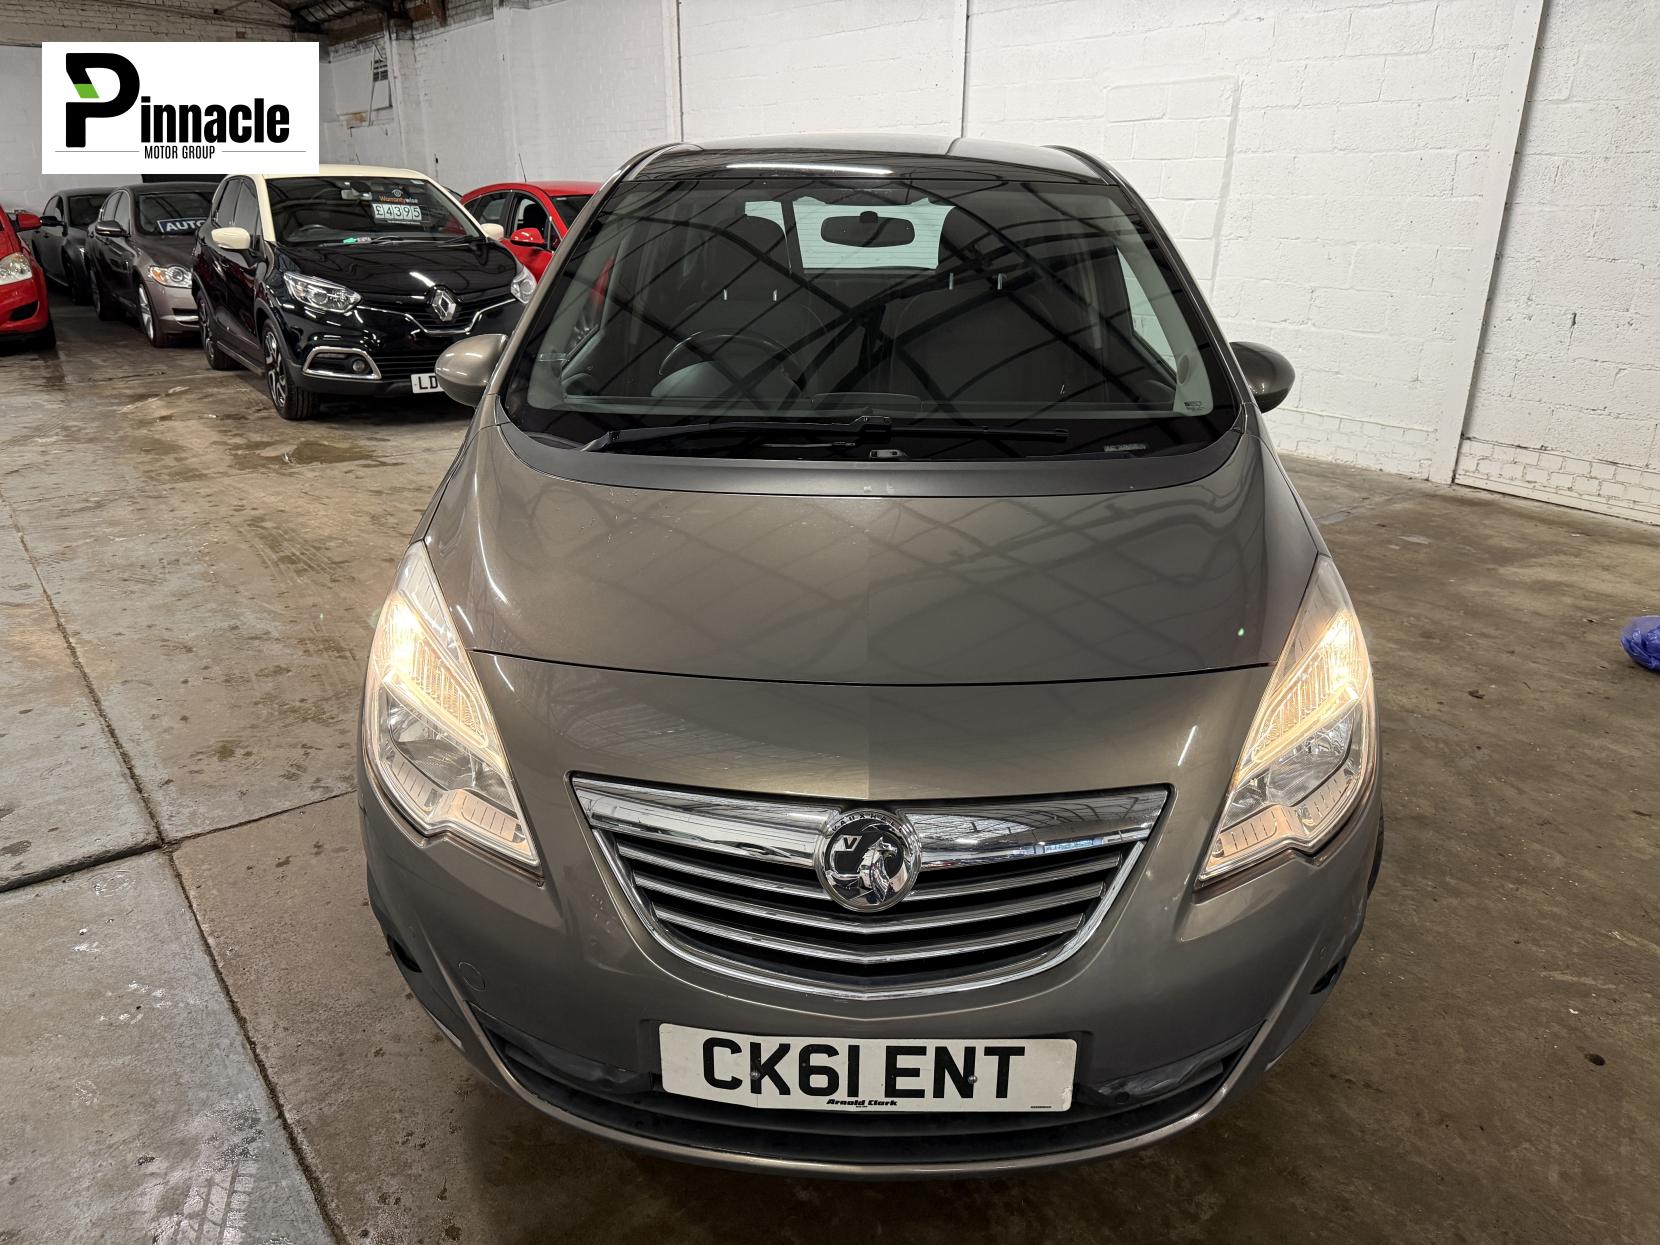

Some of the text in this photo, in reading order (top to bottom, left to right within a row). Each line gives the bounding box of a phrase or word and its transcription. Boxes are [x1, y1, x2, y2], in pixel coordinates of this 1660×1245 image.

[376, 206, 421, 218] £4395
[703, 1037, 1026, 1099] CK61 ENT
